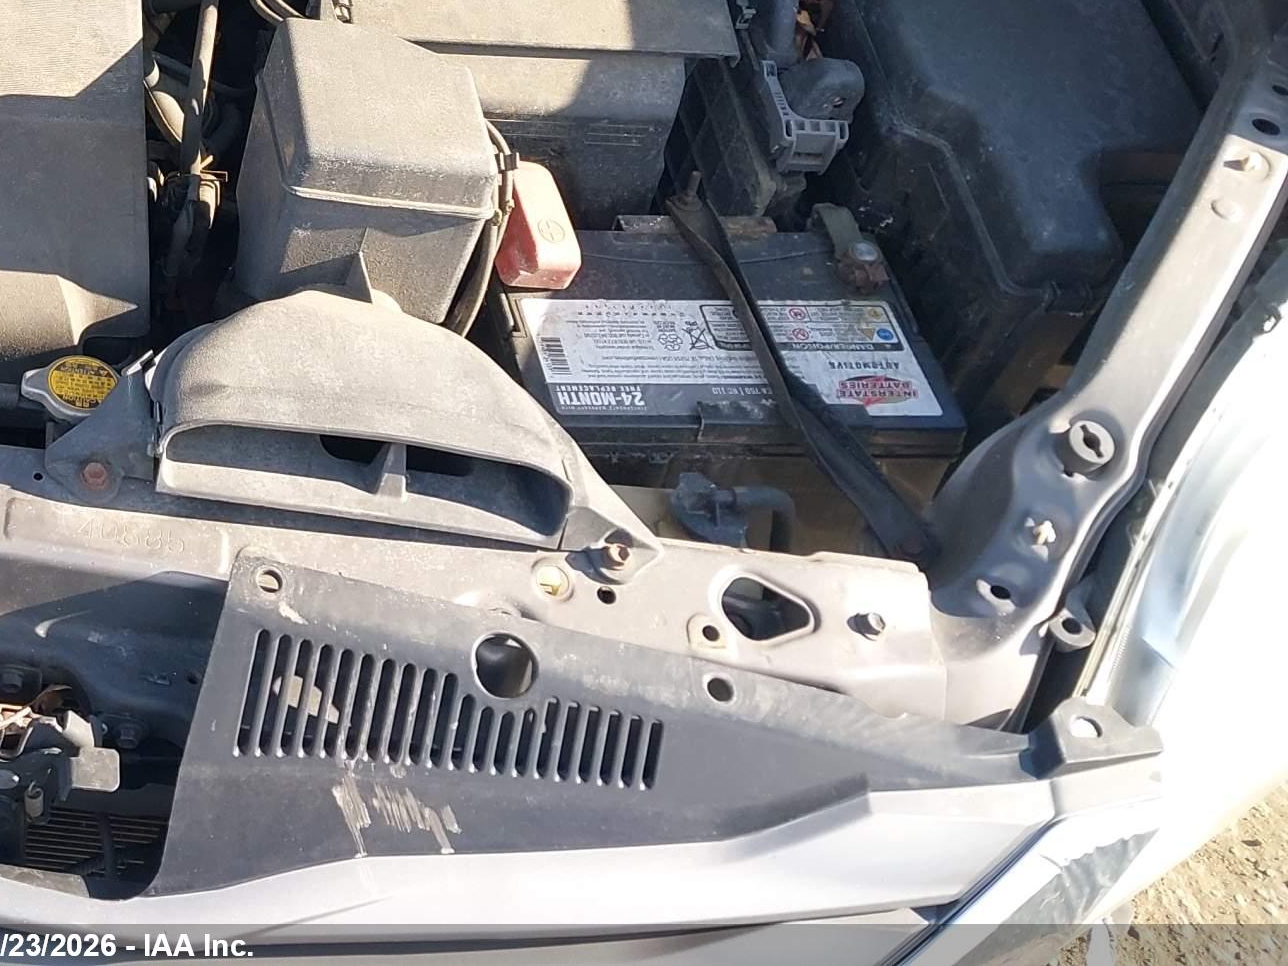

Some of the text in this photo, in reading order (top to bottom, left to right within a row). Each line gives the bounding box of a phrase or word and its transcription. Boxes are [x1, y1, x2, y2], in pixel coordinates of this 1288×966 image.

[827, 360, 901, 370] AUTOMOTIVE
[839, 381, 911, 390] BATTERIES
[838, 390, 918, 398] INTERSTATE
[558, 392, 646, 406] 24-MONTH
